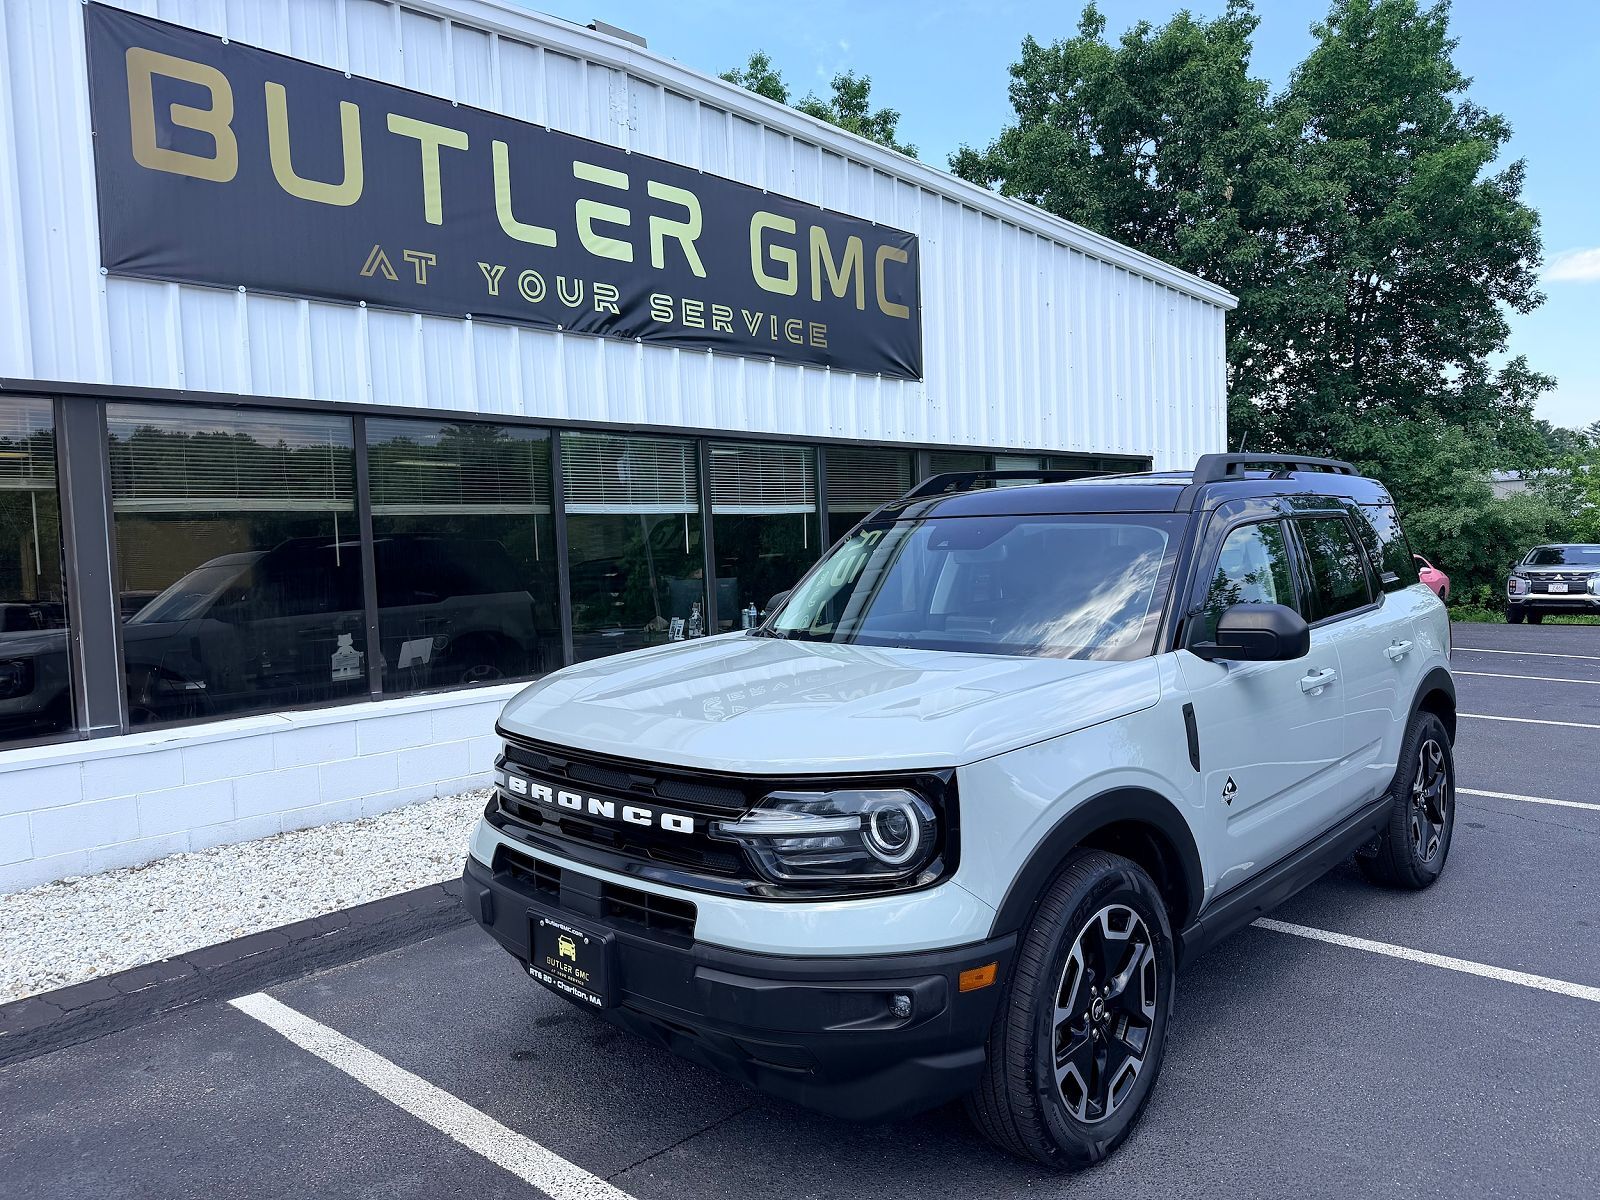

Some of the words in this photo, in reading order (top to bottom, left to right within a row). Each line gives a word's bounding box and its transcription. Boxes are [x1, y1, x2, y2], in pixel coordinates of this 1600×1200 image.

[125, 46, 707, 278] BUTLER
[749, 210, 910, 320] GMC
[359, 244, 437, 285] AT
[477, 261, 621, 315] YOUR
[649, 293, 829, 349] SERVICE
[508, 775, 695, 834] BRONCO
[546, 956, 573, 974] BUTLER
[575, 968, 590, 981] GMC
[557, 980, 588, 1001] Charlton,
[589, 994, 602, 1006] MA
